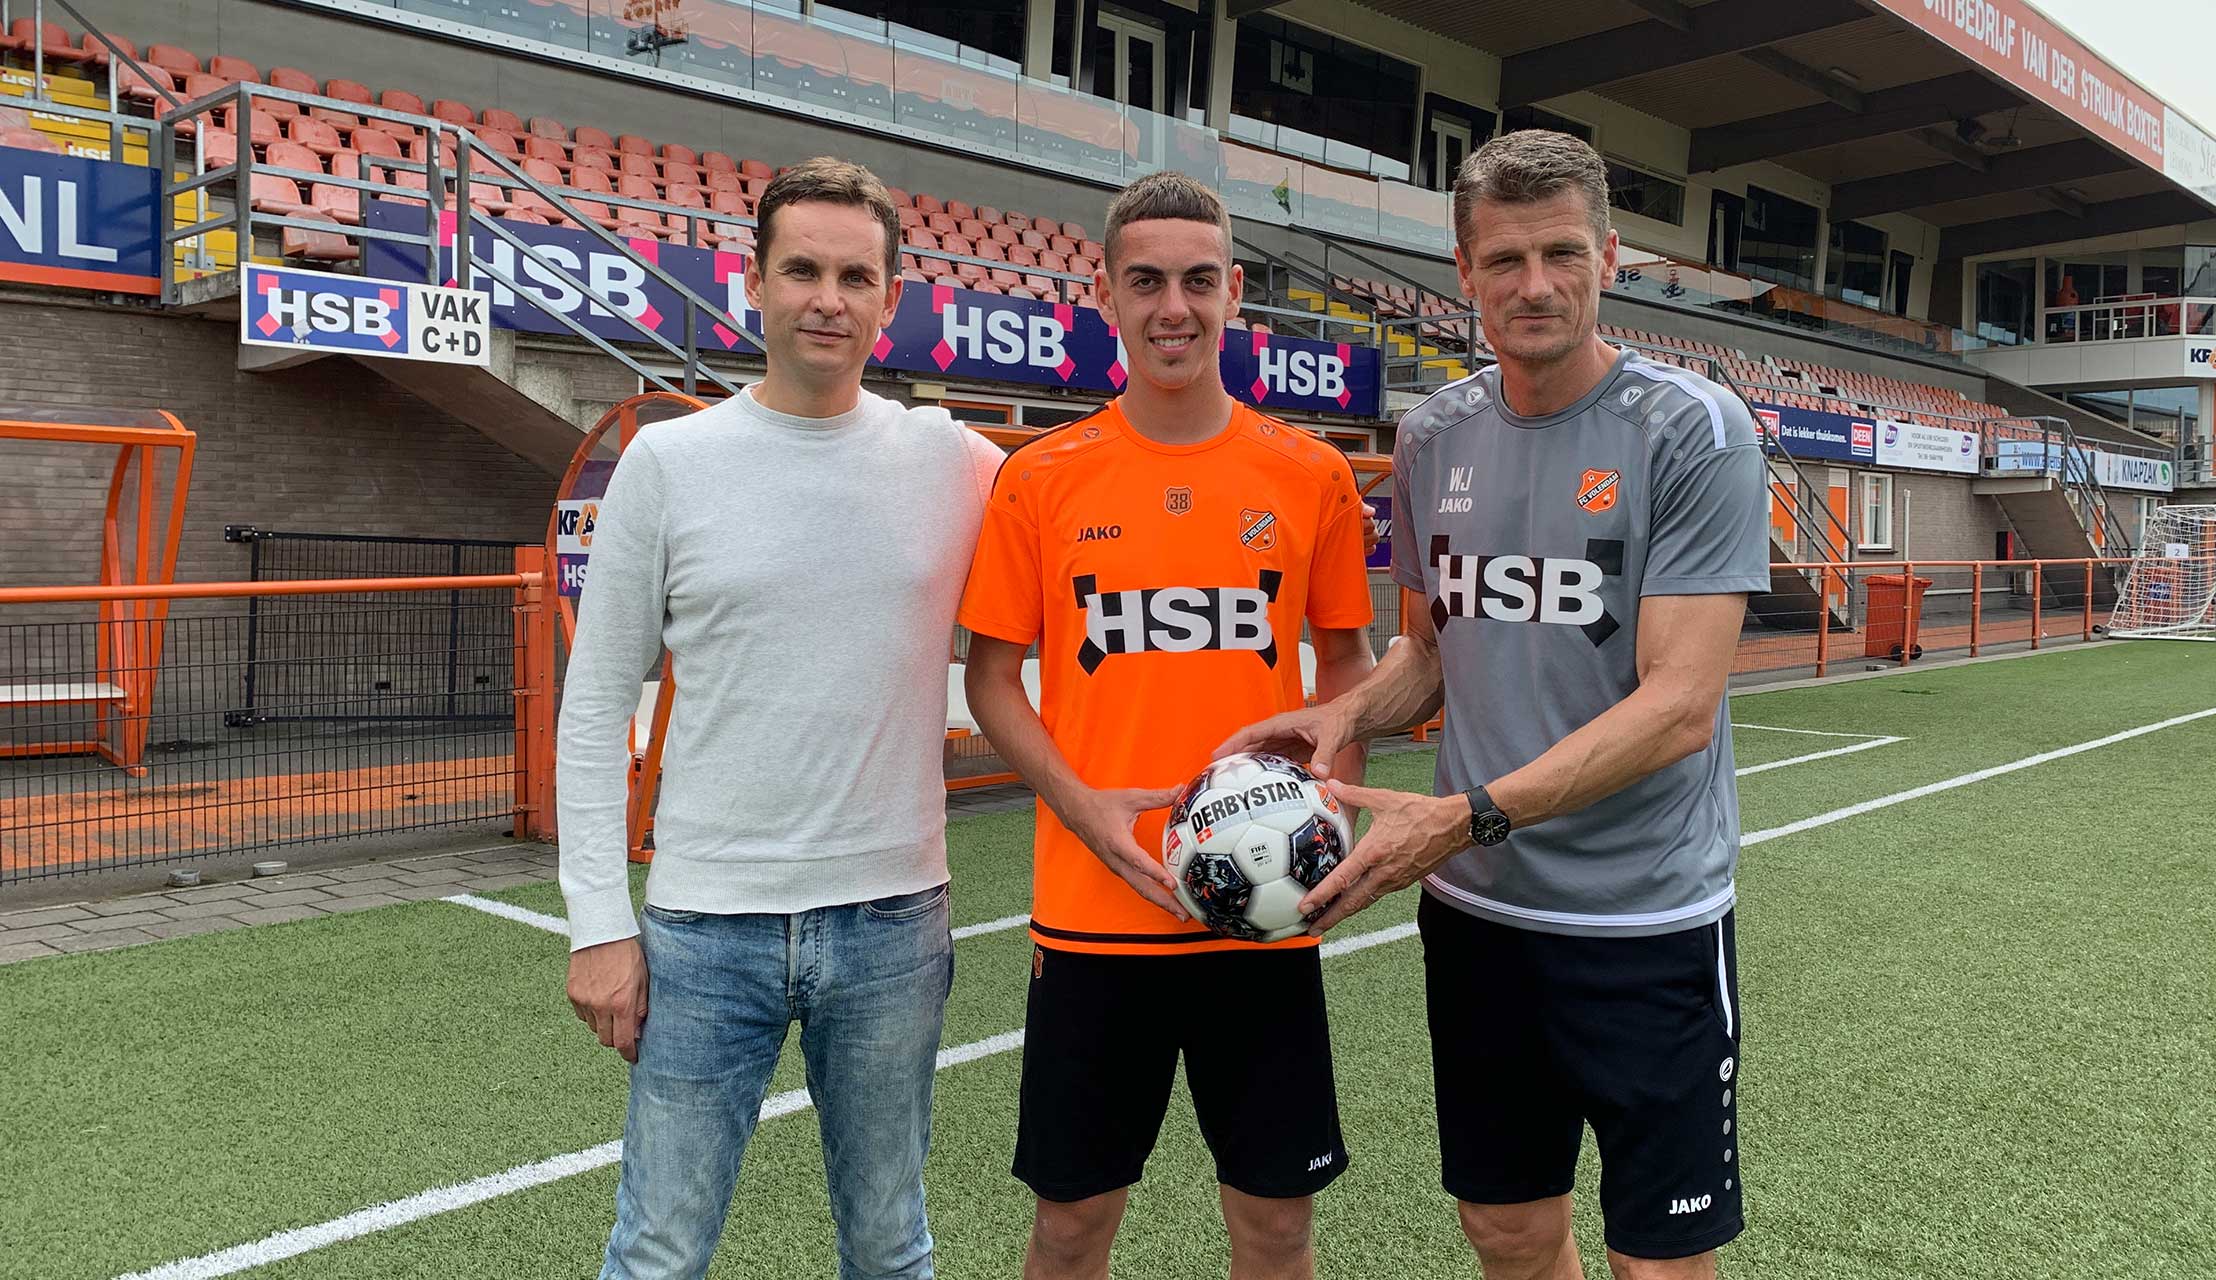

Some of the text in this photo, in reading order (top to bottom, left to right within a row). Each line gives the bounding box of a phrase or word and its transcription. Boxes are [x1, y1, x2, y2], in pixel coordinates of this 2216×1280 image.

[1923, 0, 2015, 58] BEDRIJF
[2022, 27, 2047, 82] VAN
[2051, 48, 2075, 100] DER
[2081, 68, 2125, 132] STRUIJK
[2127, 99, 2163, 156] BOXTEL
[452, 233, 648, 319] HSB
[267, 287, 393, 337] HSB
[421, 291, 482, 325] VAK
[421, 326, 482, 357] C+D
[943, 303, 1066, 368] HSB
[1259, 347, 1345, 398] HSB
[1781, 425, 1792, 437] Dat
[1793, 426, 1798, 438] is
[1853, 428, 1872, 443] DEEN
[1448, 466, 1474, 492] WJ
[2122, 459, 2158, 484] KNAPZAK
[1169, 493, 1188, 511] 38
[1438, 497, 1473, 514] JAKO
[1076, 524, 1122, 542] JAKO
[2174, 548, 2180, 557] 2
[563, 563, 590, 588] HS
[1438, 555, 1605, 626] HSB
[1084, 586, 1274, 655] HSB
[1191, 781, 1304, 834] DERBYSTAR
[1250, 844, 1267, 854] FIFA
[1669, 1194, 1711, 1214] JAKO
